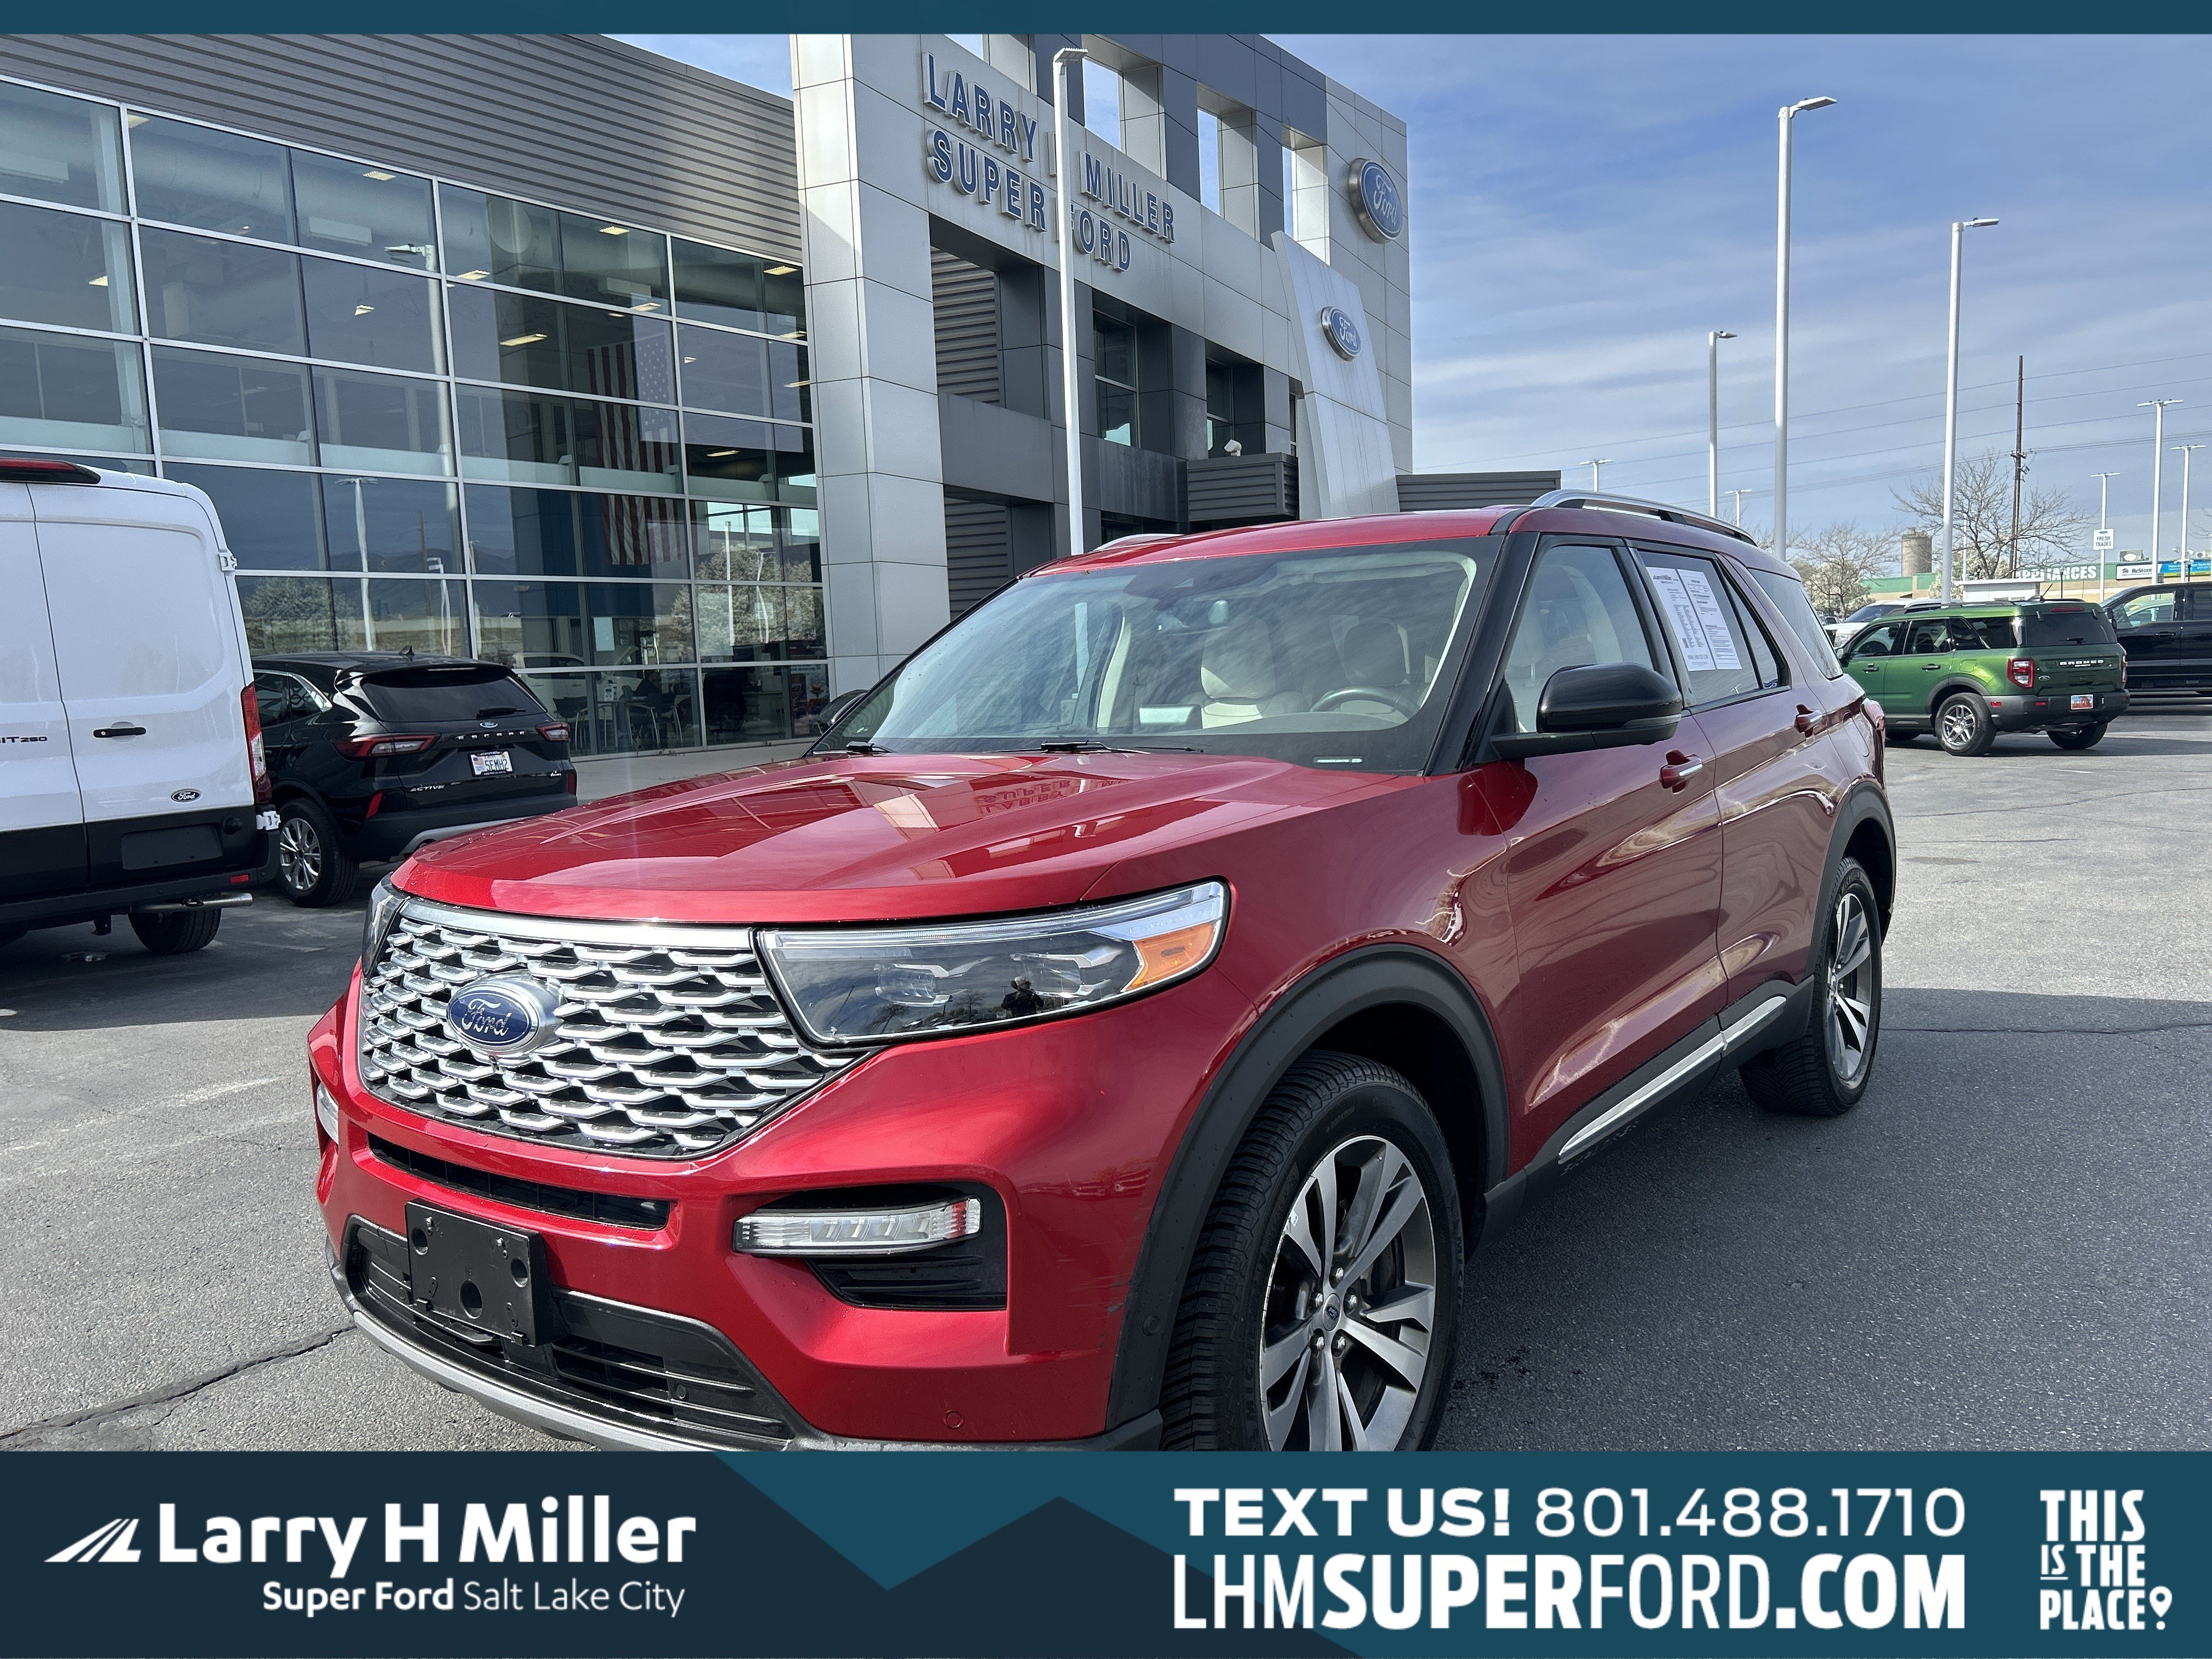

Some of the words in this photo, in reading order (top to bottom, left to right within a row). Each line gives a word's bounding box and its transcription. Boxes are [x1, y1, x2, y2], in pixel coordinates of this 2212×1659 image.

[924, 51, 1038, 163] LARRY
[1079, 150, 1175, 244] MILLER
[927, 128, 1047, 232] SUPER
[1373, 174, 1398, 227] Ford
[1339, 316, 1358, 348] Ford
[461, 998, 512, 1037] Ford
